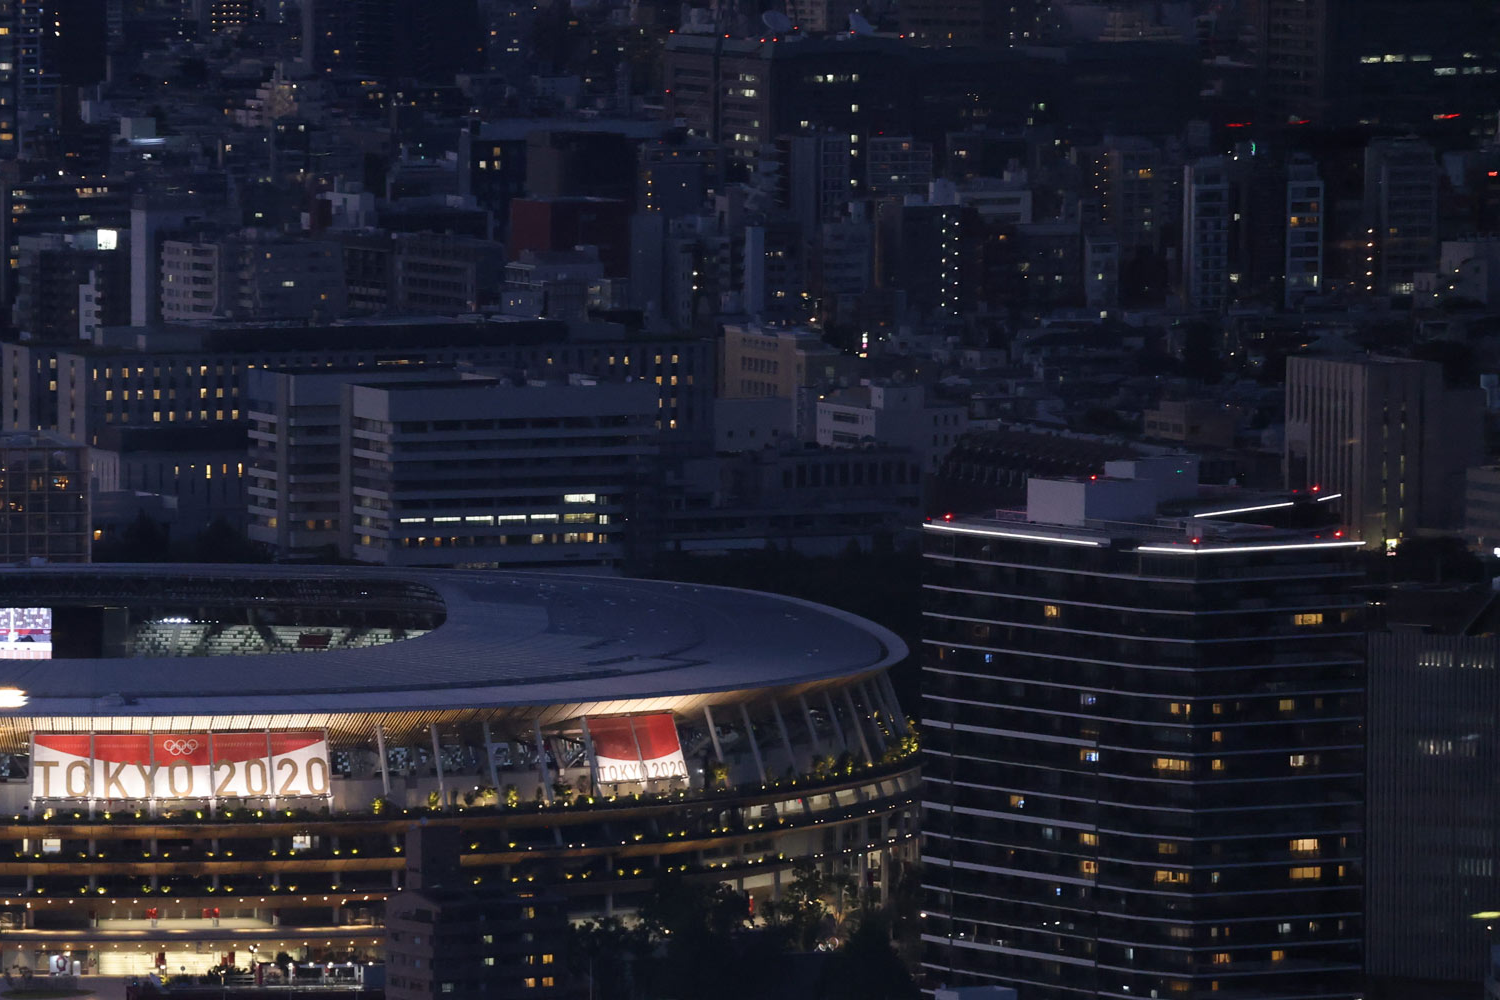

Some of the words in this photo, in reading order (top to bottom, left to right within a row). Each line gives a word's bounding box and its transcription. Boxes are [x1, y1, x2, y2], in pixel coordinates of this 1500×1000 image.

[34, 760, 193, 798] TOKYO
[214, 757, 329, 796] 2020
[598, 763, 649, 782] TOKYO
[652, 760, 686, 778] 2020
